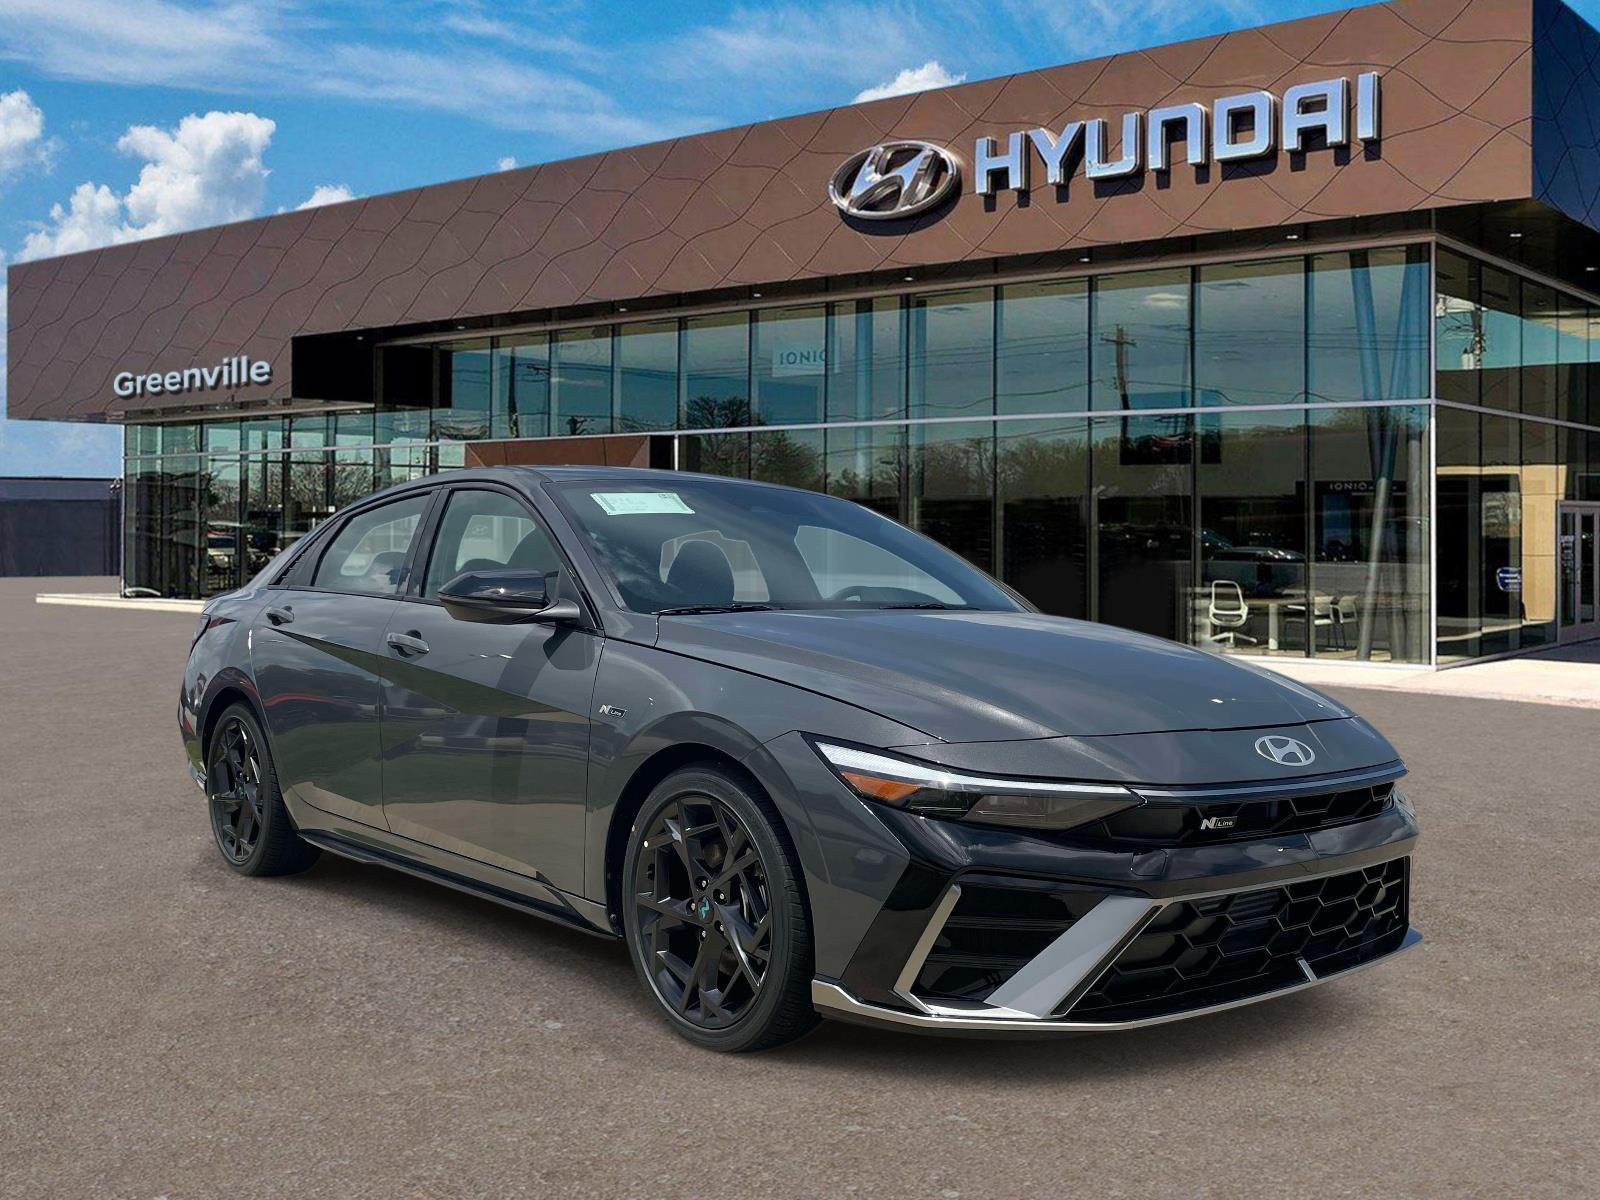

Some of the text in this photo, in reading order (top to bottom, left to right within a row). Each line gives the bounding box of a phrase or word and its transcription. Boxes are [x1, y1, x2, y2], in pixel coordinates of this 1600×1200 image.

[974, 71, 1379, 197] HYUNDAI
[113, 355, 271, 396] Greenville
[1200, 816, 1217, 830] N
